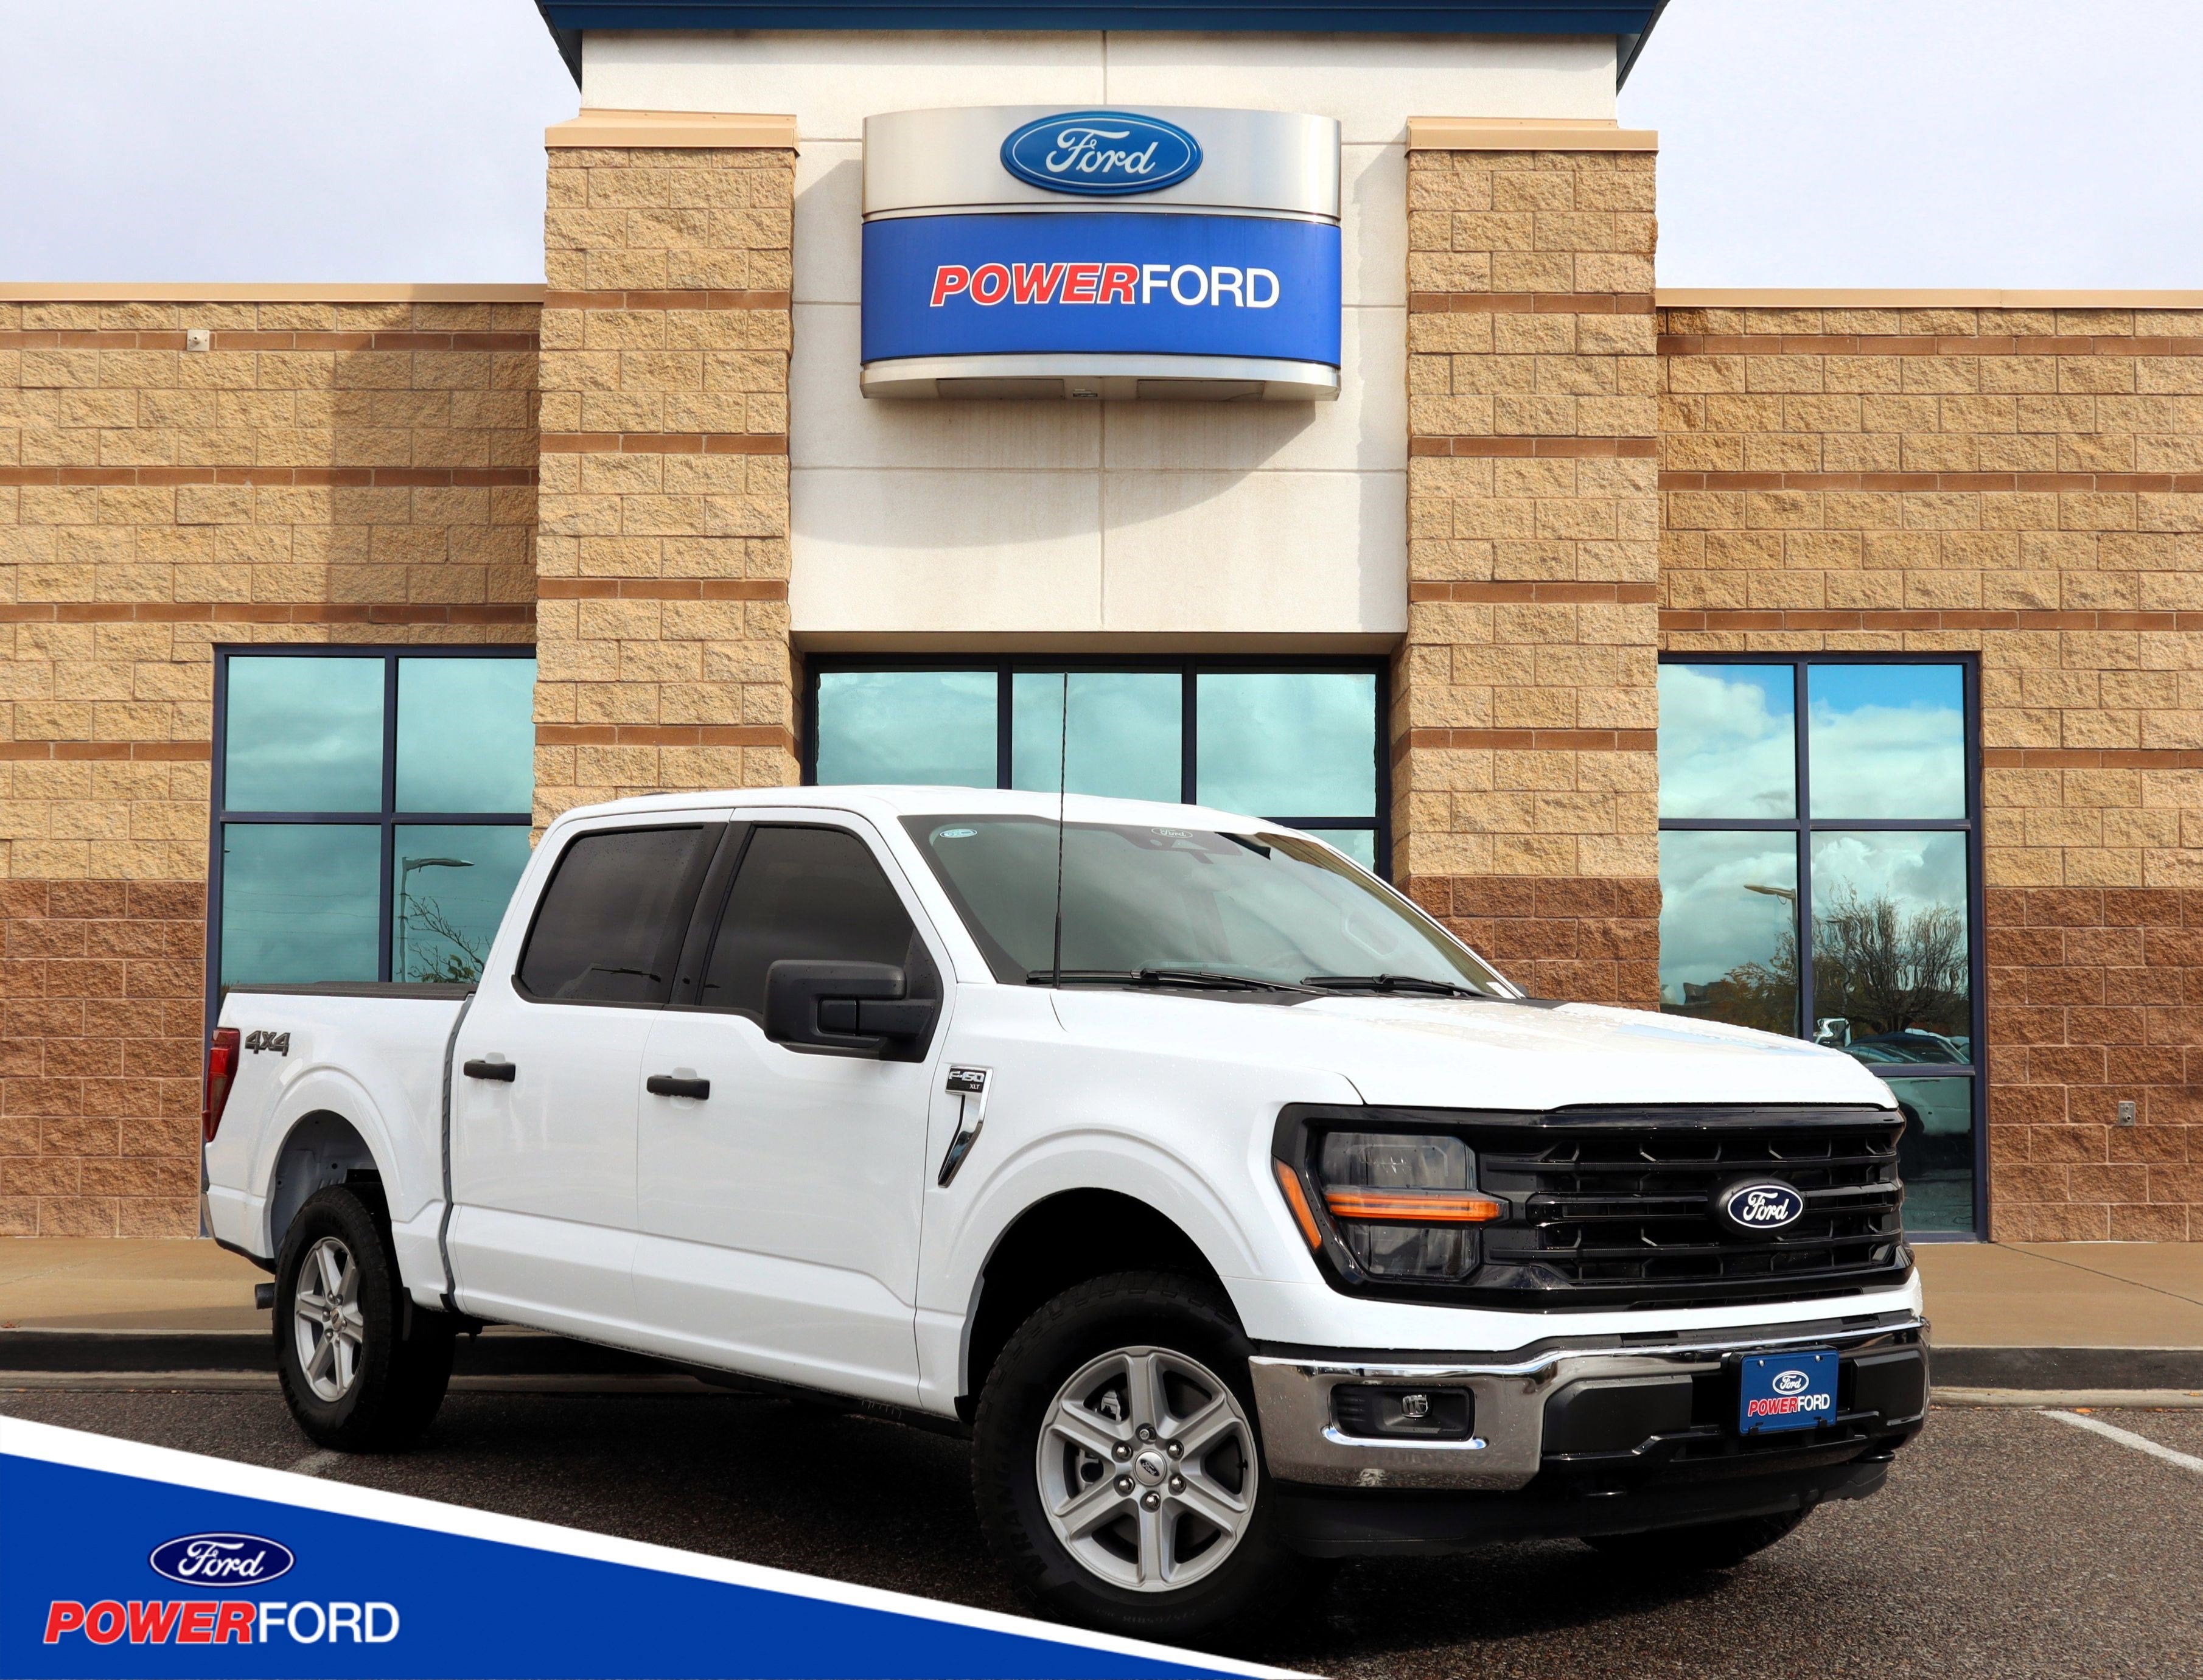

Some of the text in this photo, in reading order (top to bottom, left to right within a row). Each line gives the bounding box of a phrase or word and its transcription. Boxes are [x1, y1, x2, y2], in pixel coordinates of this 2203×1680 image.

[1045, 127, 1158, 174] Ford
[1743, 1190, 1789, 1221] Ford
[1779, 1375, 1802, 1390] Ford
